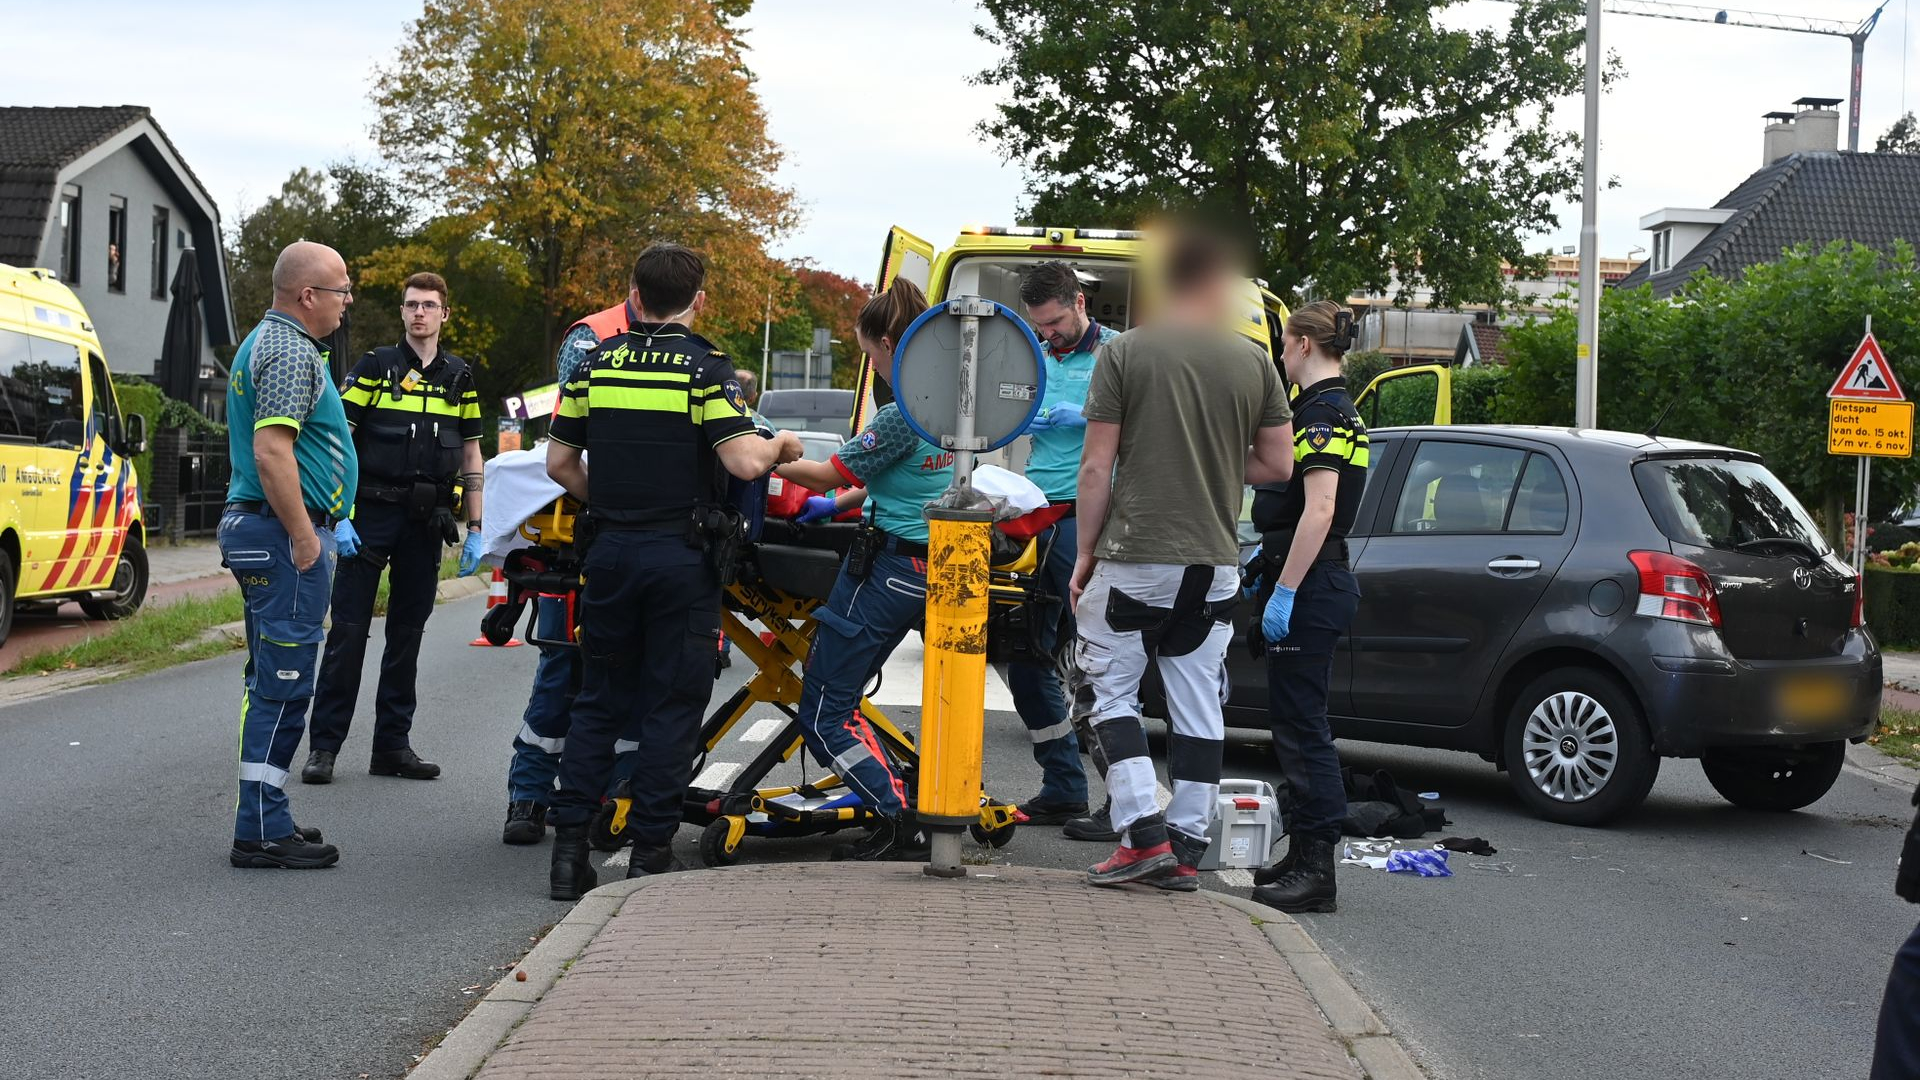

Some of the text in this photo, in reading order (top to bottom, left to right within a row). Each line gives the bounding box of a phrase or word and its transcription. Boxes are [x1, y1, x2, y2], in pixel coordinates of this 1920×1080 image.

[506, 397, 521, 419] P
[1835, 403, 1877, 414] fietspad
[1834, 415, 1859, 424] dicht
[1855, 427, 1871, 436] do.
[1875, 428, 1884, 437] 15
[1888, 430, 1907, 439] okt.
[1832, 438, 1908, 451] t/m vr. 6 nov.
